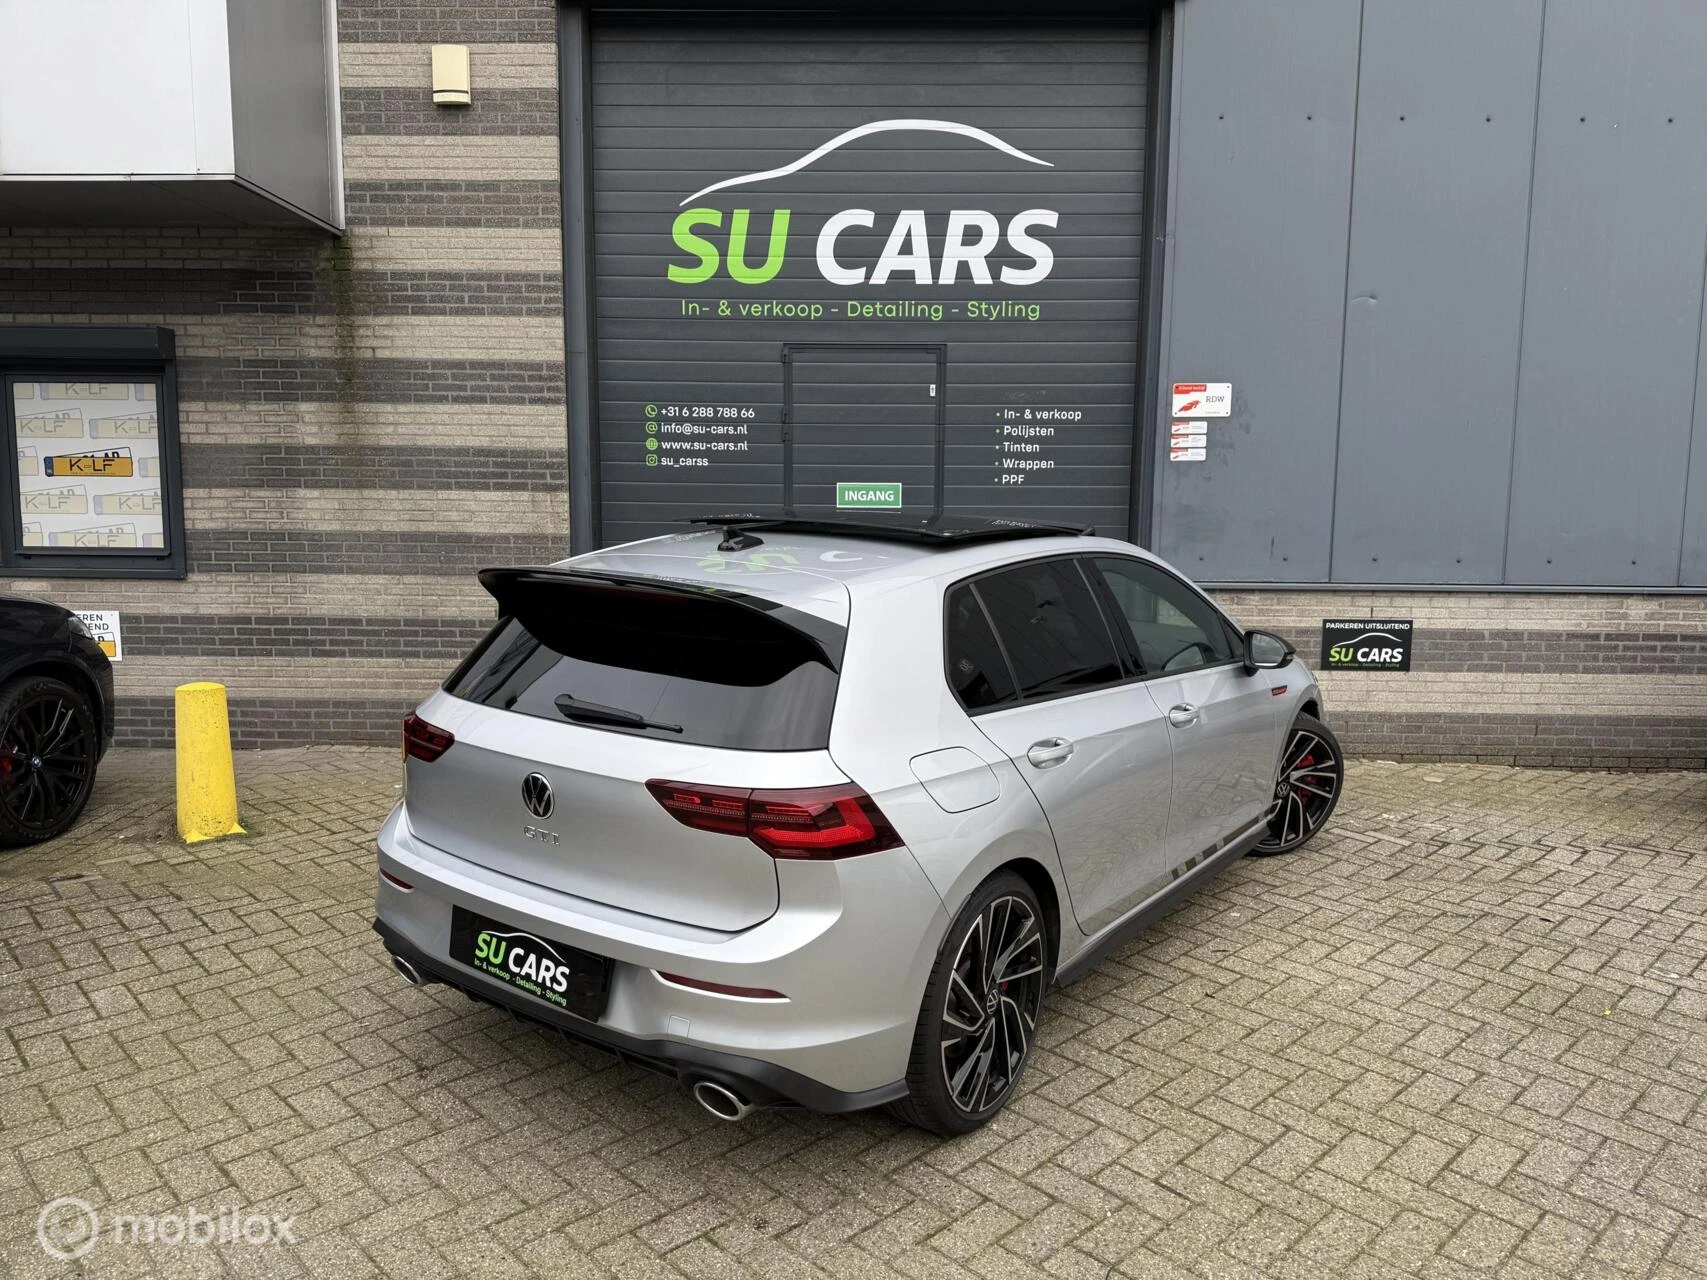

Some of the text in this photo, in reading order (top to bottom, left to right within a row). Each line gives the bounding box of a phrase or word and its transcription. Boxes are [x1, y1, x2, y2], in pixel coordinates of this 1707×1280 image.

[667, 207, 1059, 286] SU CARS
[681, 300, 710, 315] In-
[718, 300, 731, 316] &
[739, 300, 823, 320] verkoop
[847, 300, 943, 321] Detailing
[967, 301, 1040, 321] Styling
[1205, 395, 1225, 403] RDW
[661, 406, 755, 418] +31 6 288 788 66
[1004, 408, 1082, 421] In- & verkoop
[661, 422, 748, 434] info@su-cars.nl
[1003, 425, 1055, 438] Polijsten
[661, 440, 748, 451] www.su-cars.nl
[1003, 441, 1040, 452] Tinten
[660, 456, 709, 467] su_carss
[1002, 458, 1055, 471] Wrappen
[1002, 474, 1025, 484] PPF
[844, 490, 895, 501] INGANG
[1365, 622, 1410, 630] UITSLUITEND
[1328, 647, 1404, 663] SU CARS
[524, 825, 560, 846] GTI
[475, 933, 570, 993] SU CARS
[487, 964, 511, 981] verkoop
[516, 976, 542, 996] Detailing
[545, 989, 567, 1007] Styling
